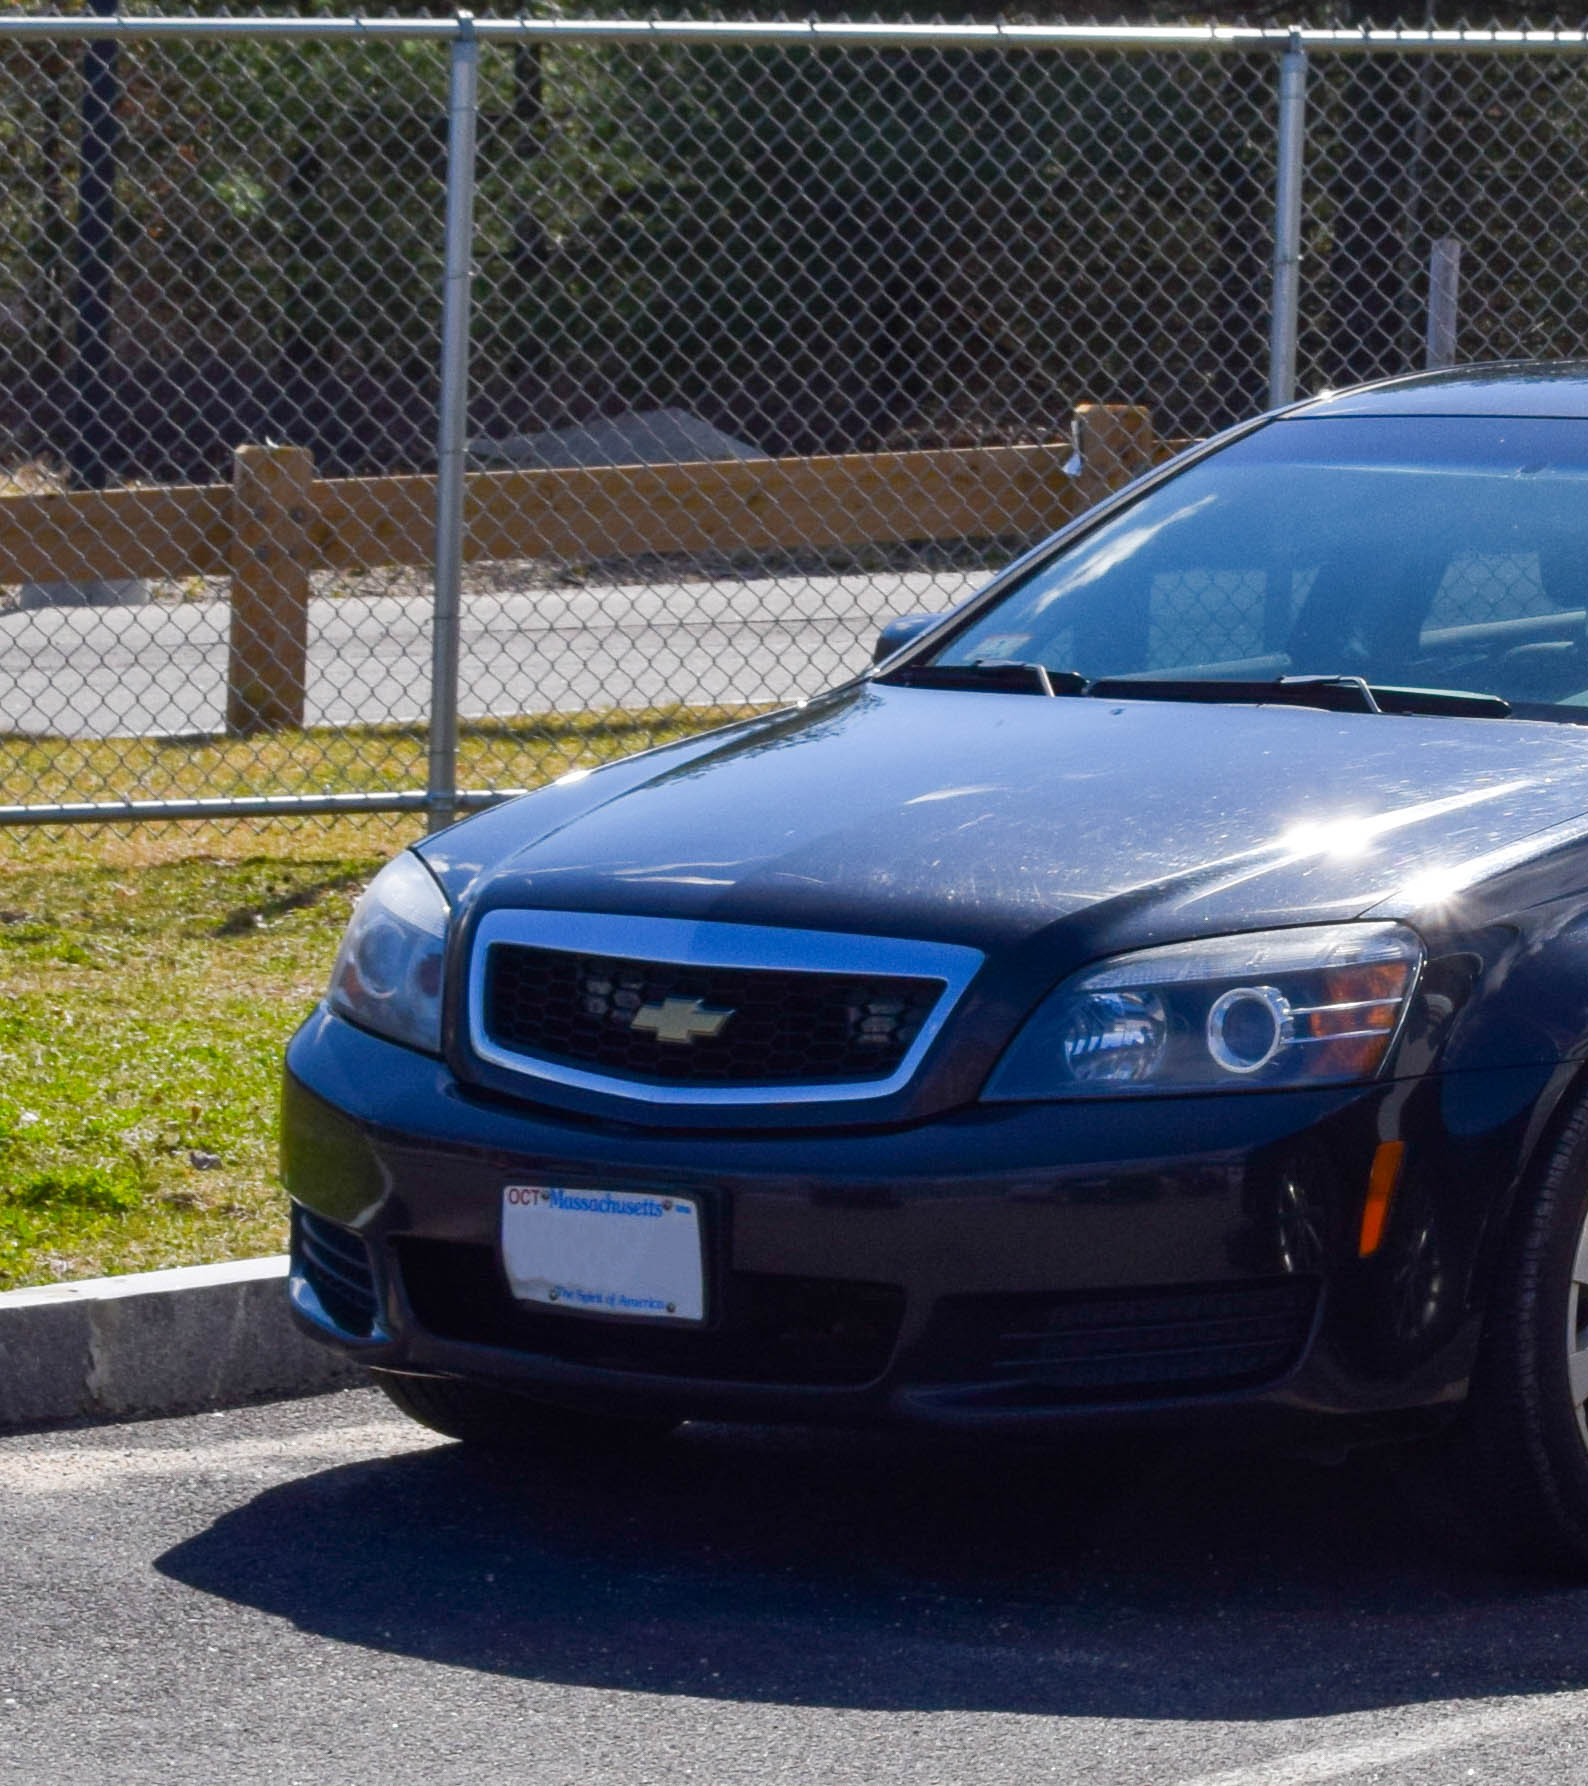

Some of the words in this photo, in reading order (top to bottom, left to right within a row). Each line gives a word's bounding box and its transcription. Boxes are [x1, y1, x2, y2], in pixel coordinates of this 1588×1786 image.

[509, 1188, 540, 1206] OCT
[550, 1188, 663, 1217] Massachusetts
[555, 1285, 573, 1299] The
[619, 1294, 664, 1310] America
